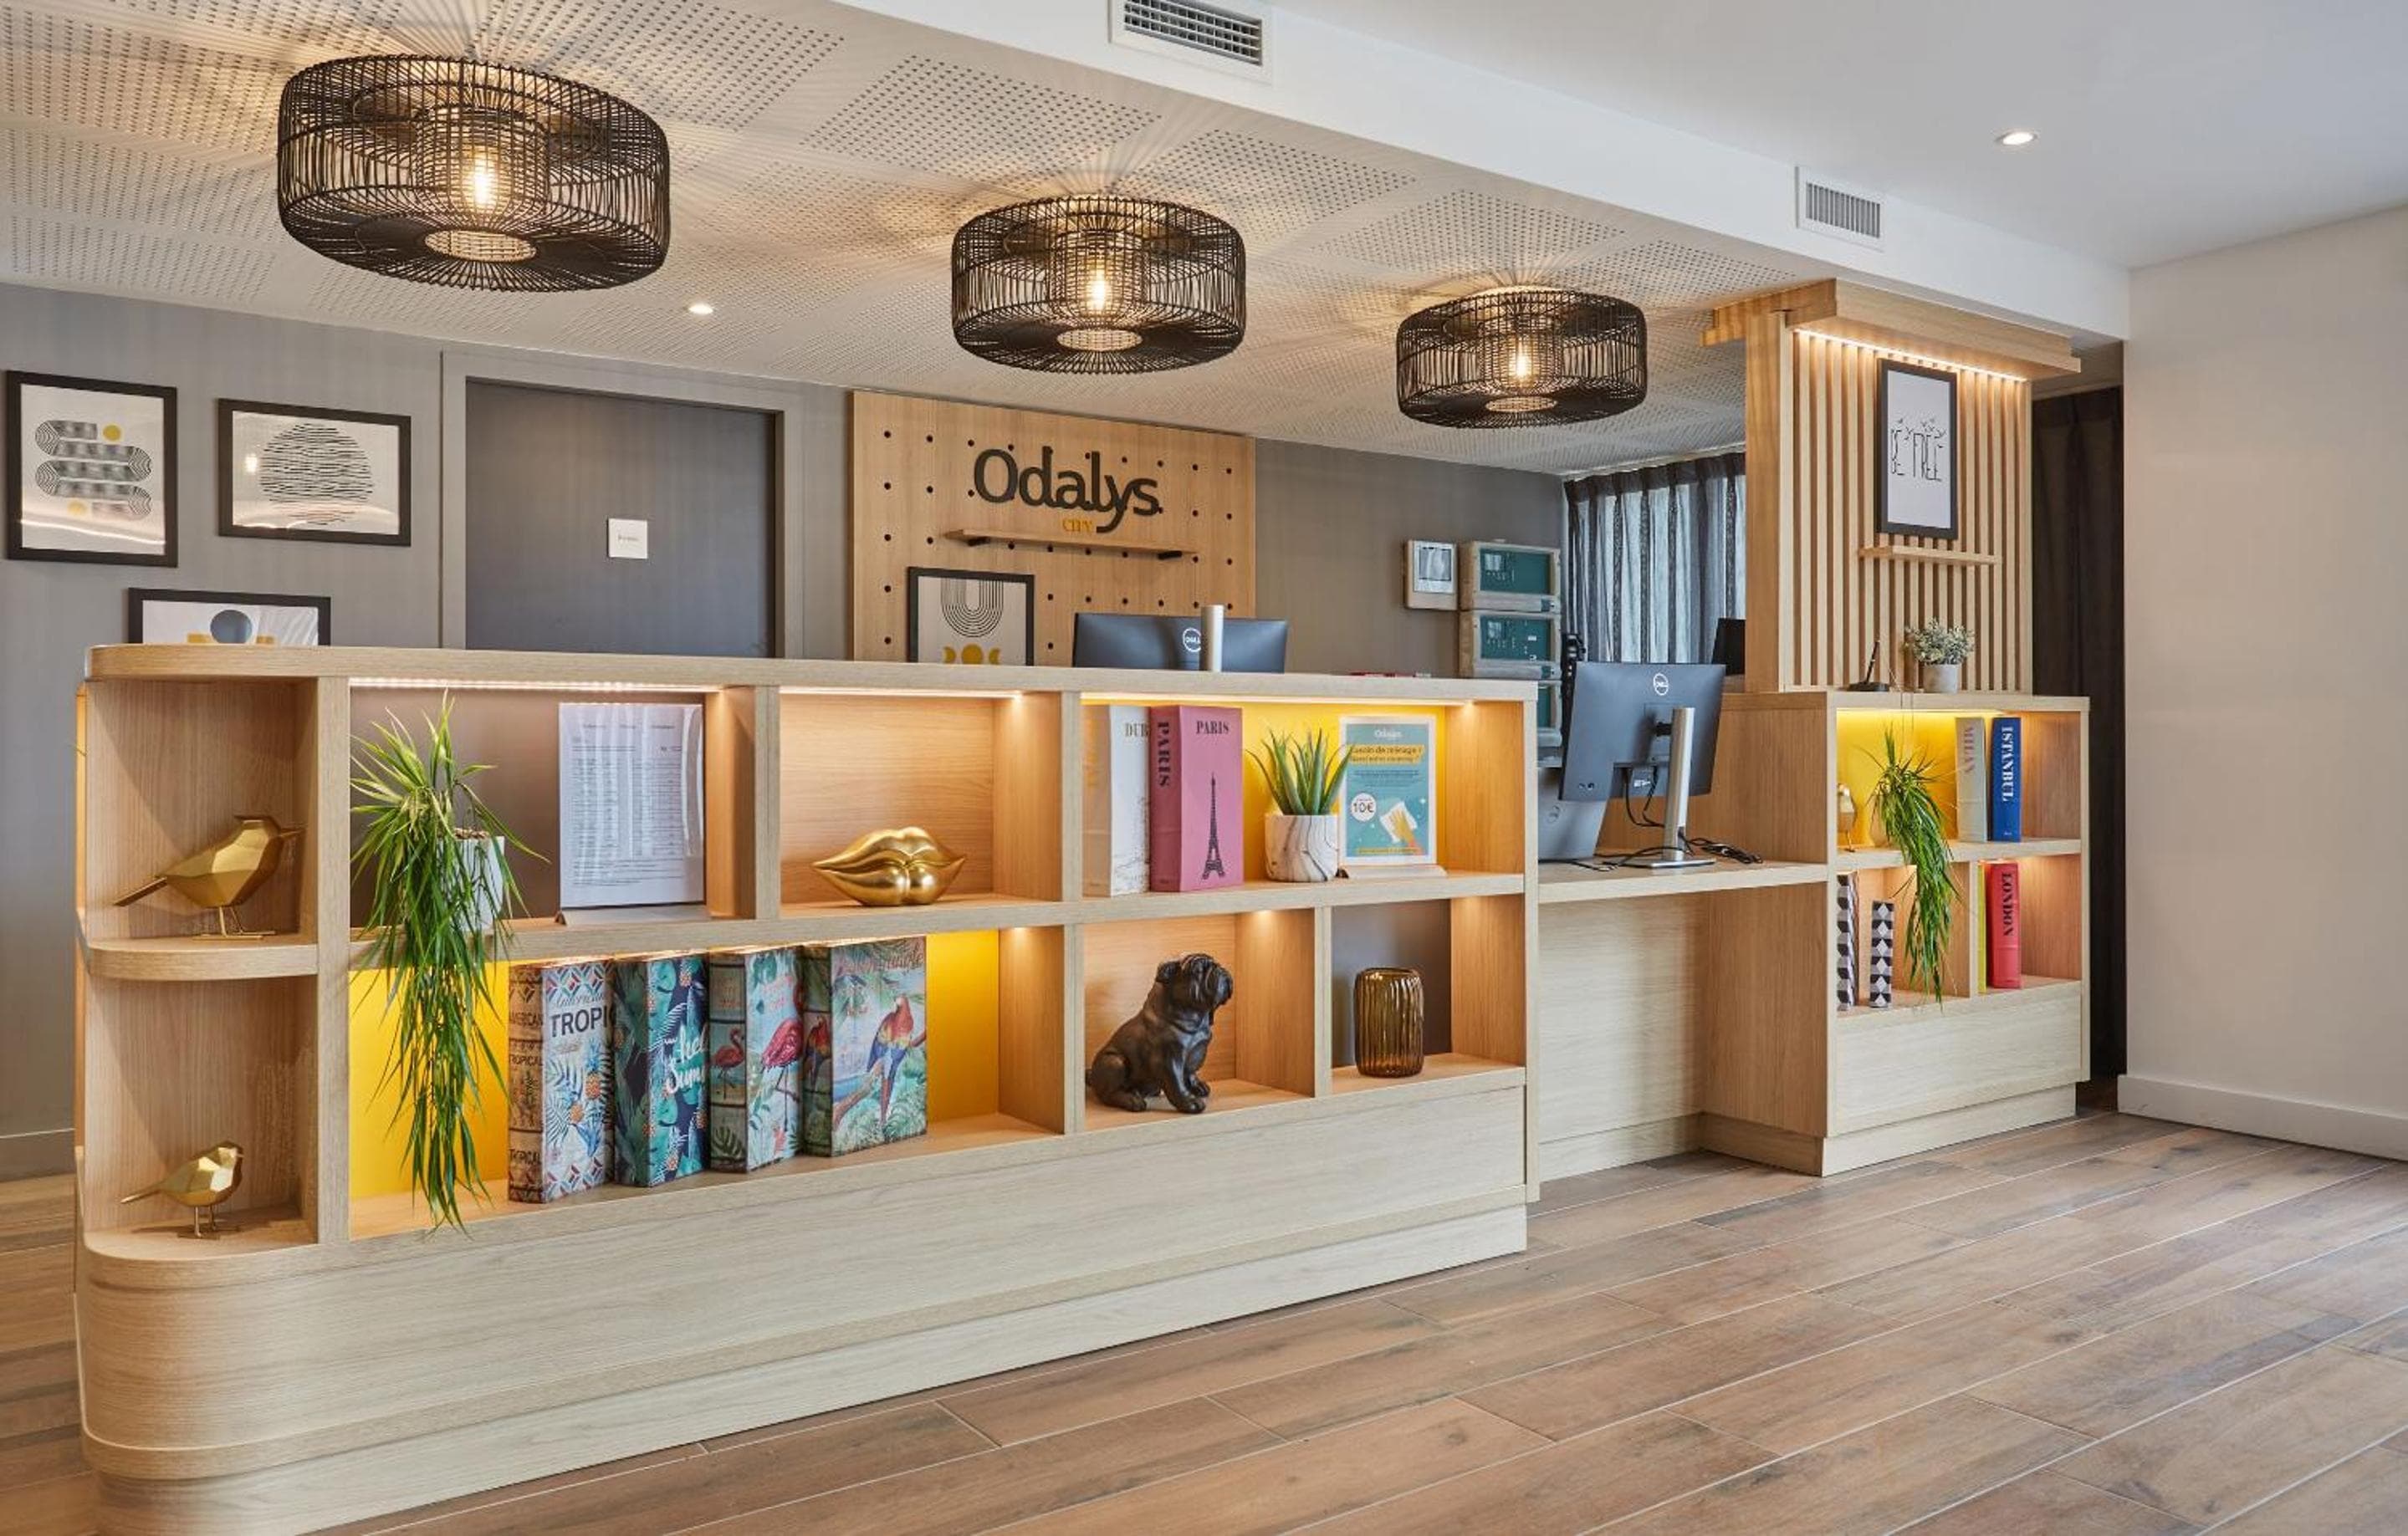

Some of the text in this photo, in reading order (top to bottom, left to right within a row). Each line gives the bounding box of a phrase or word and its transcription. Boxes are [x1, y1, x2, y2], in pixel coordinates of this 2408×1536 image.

[974, 446, 1159, 533] Odalys
[1061, 518, 1093, 533] CITY
[1158, 722, 1171, 787] PARIS
[1196, 721, 1230, 734] PARIS
[2002, 726, 2014, 803] ISTANBUL
[1352, 802, 1374, 813] 10€
[2002, 871, 2014, 937] LONDON
